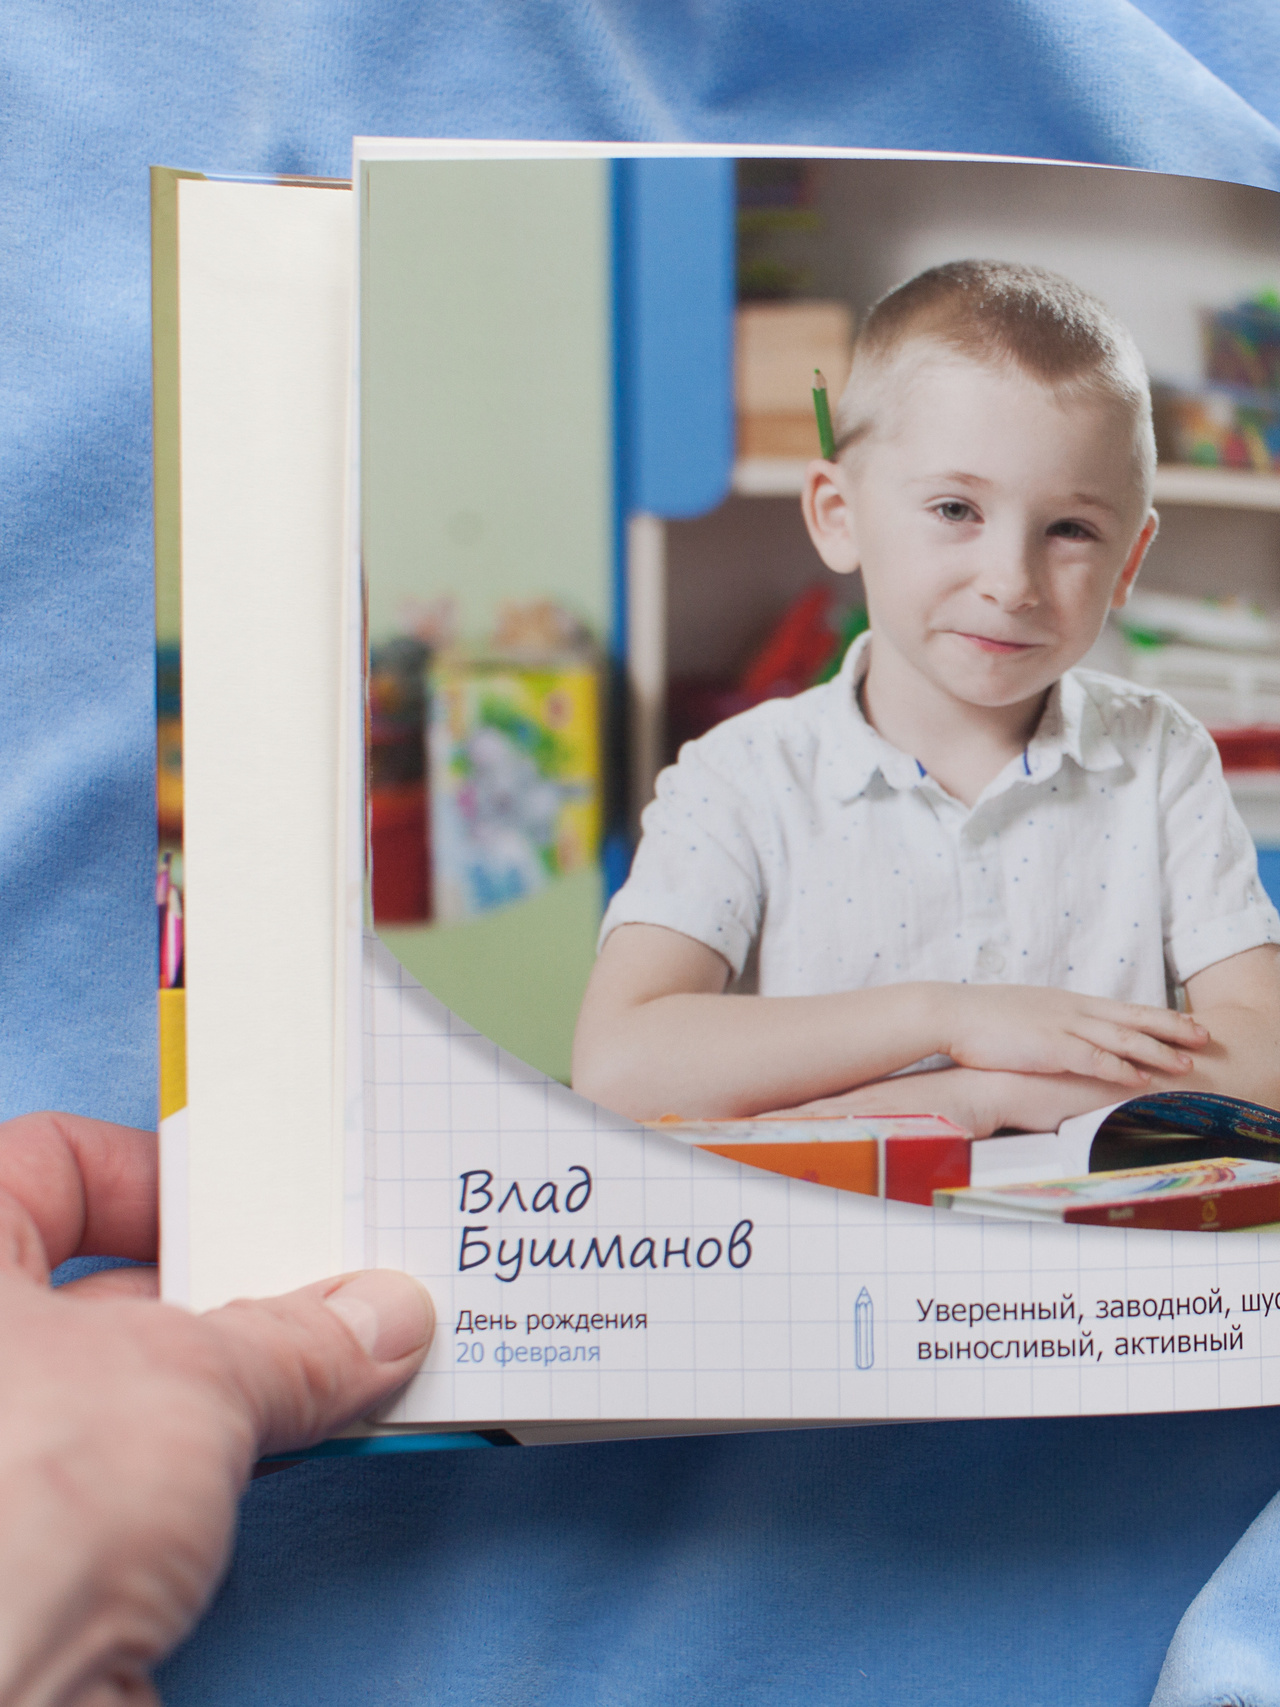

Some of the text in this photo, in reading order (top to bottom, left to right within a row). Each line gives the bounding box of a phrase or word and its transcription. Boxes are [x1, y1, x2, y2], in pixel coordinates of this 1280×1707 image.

[459, 1165, 592, 1215] Влад
[458, 1219, 754, 1283] Бушманов
[454, 1309, 648, 1336] День рождения
[916, 1293, 1084, 1328] Уверенный,
[1095, 1287, 1231, 1324] заводной,
[456, 1341, 601, 1368] 20 февраля
[918, 1323, 1243, 1362] выносливый, активный
